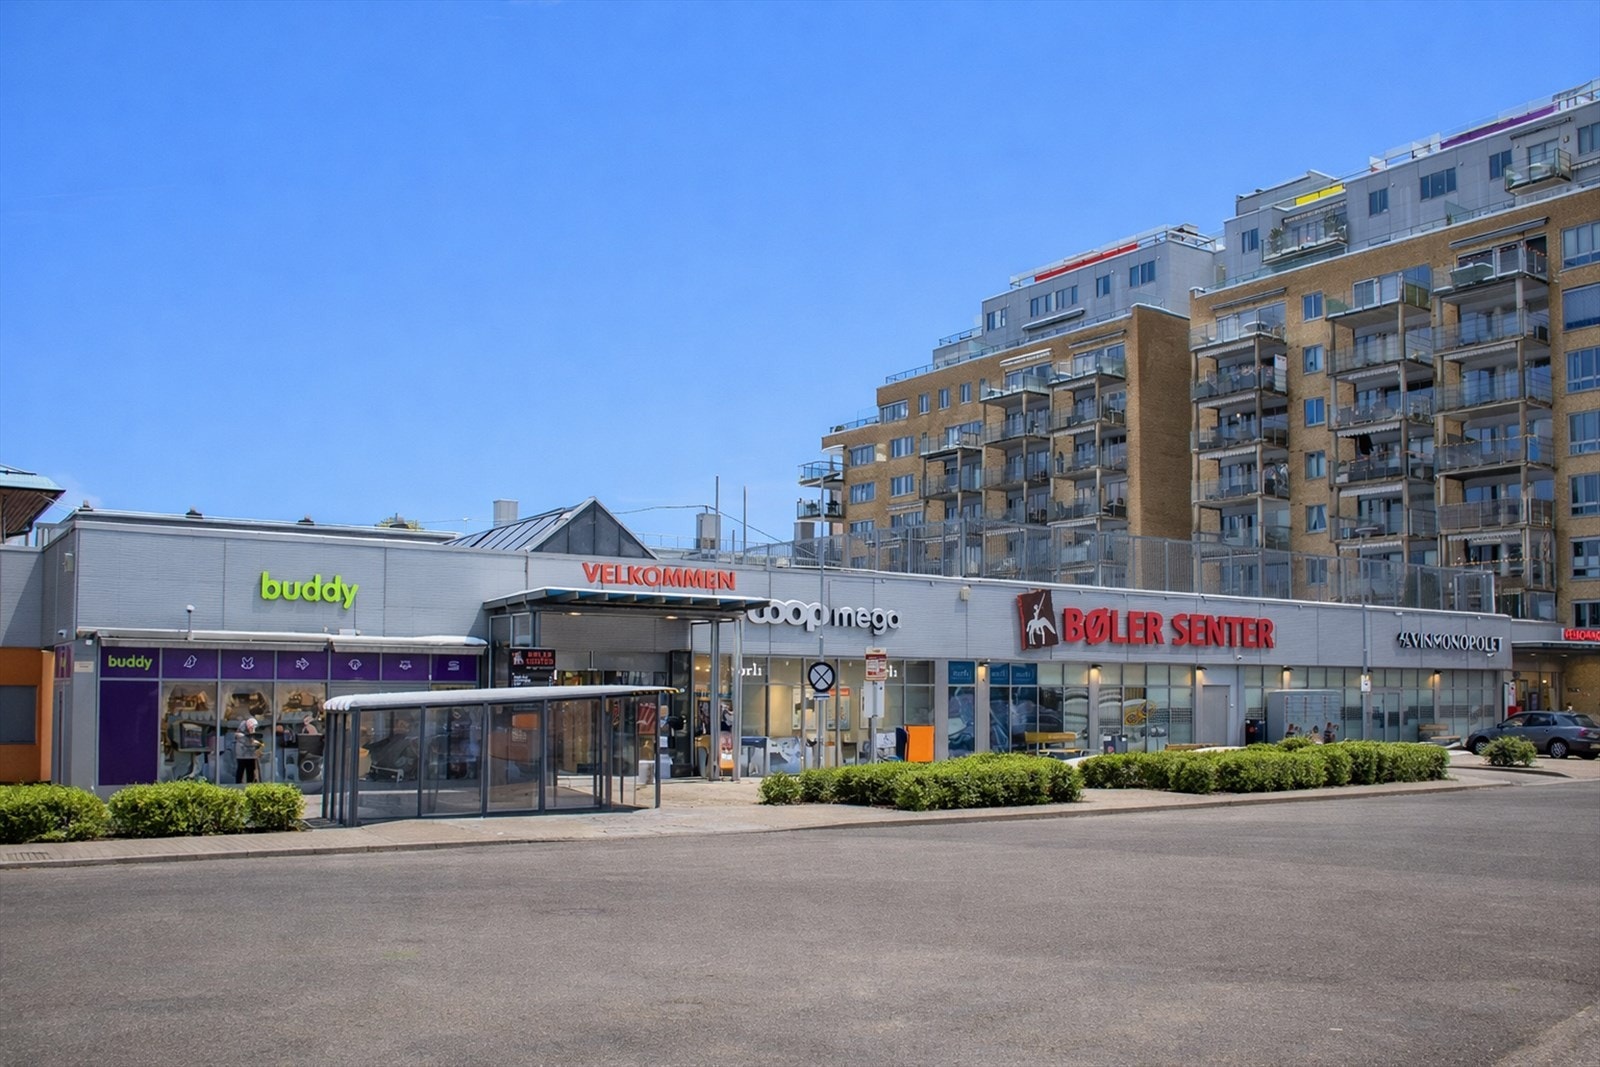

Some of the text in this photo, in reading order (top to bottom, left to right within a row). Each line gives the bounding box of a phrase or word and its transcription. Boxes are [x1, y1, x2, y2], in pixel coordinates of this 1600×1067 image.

[261, 571, 359, 609] buddy
[582, 562, 736, 591] VELKOMMEN
[832, 607, 901, 635] mega
[1062, 607, 1274, 649] BØLER SENTER
[107, 654, 153, 671] buddy
